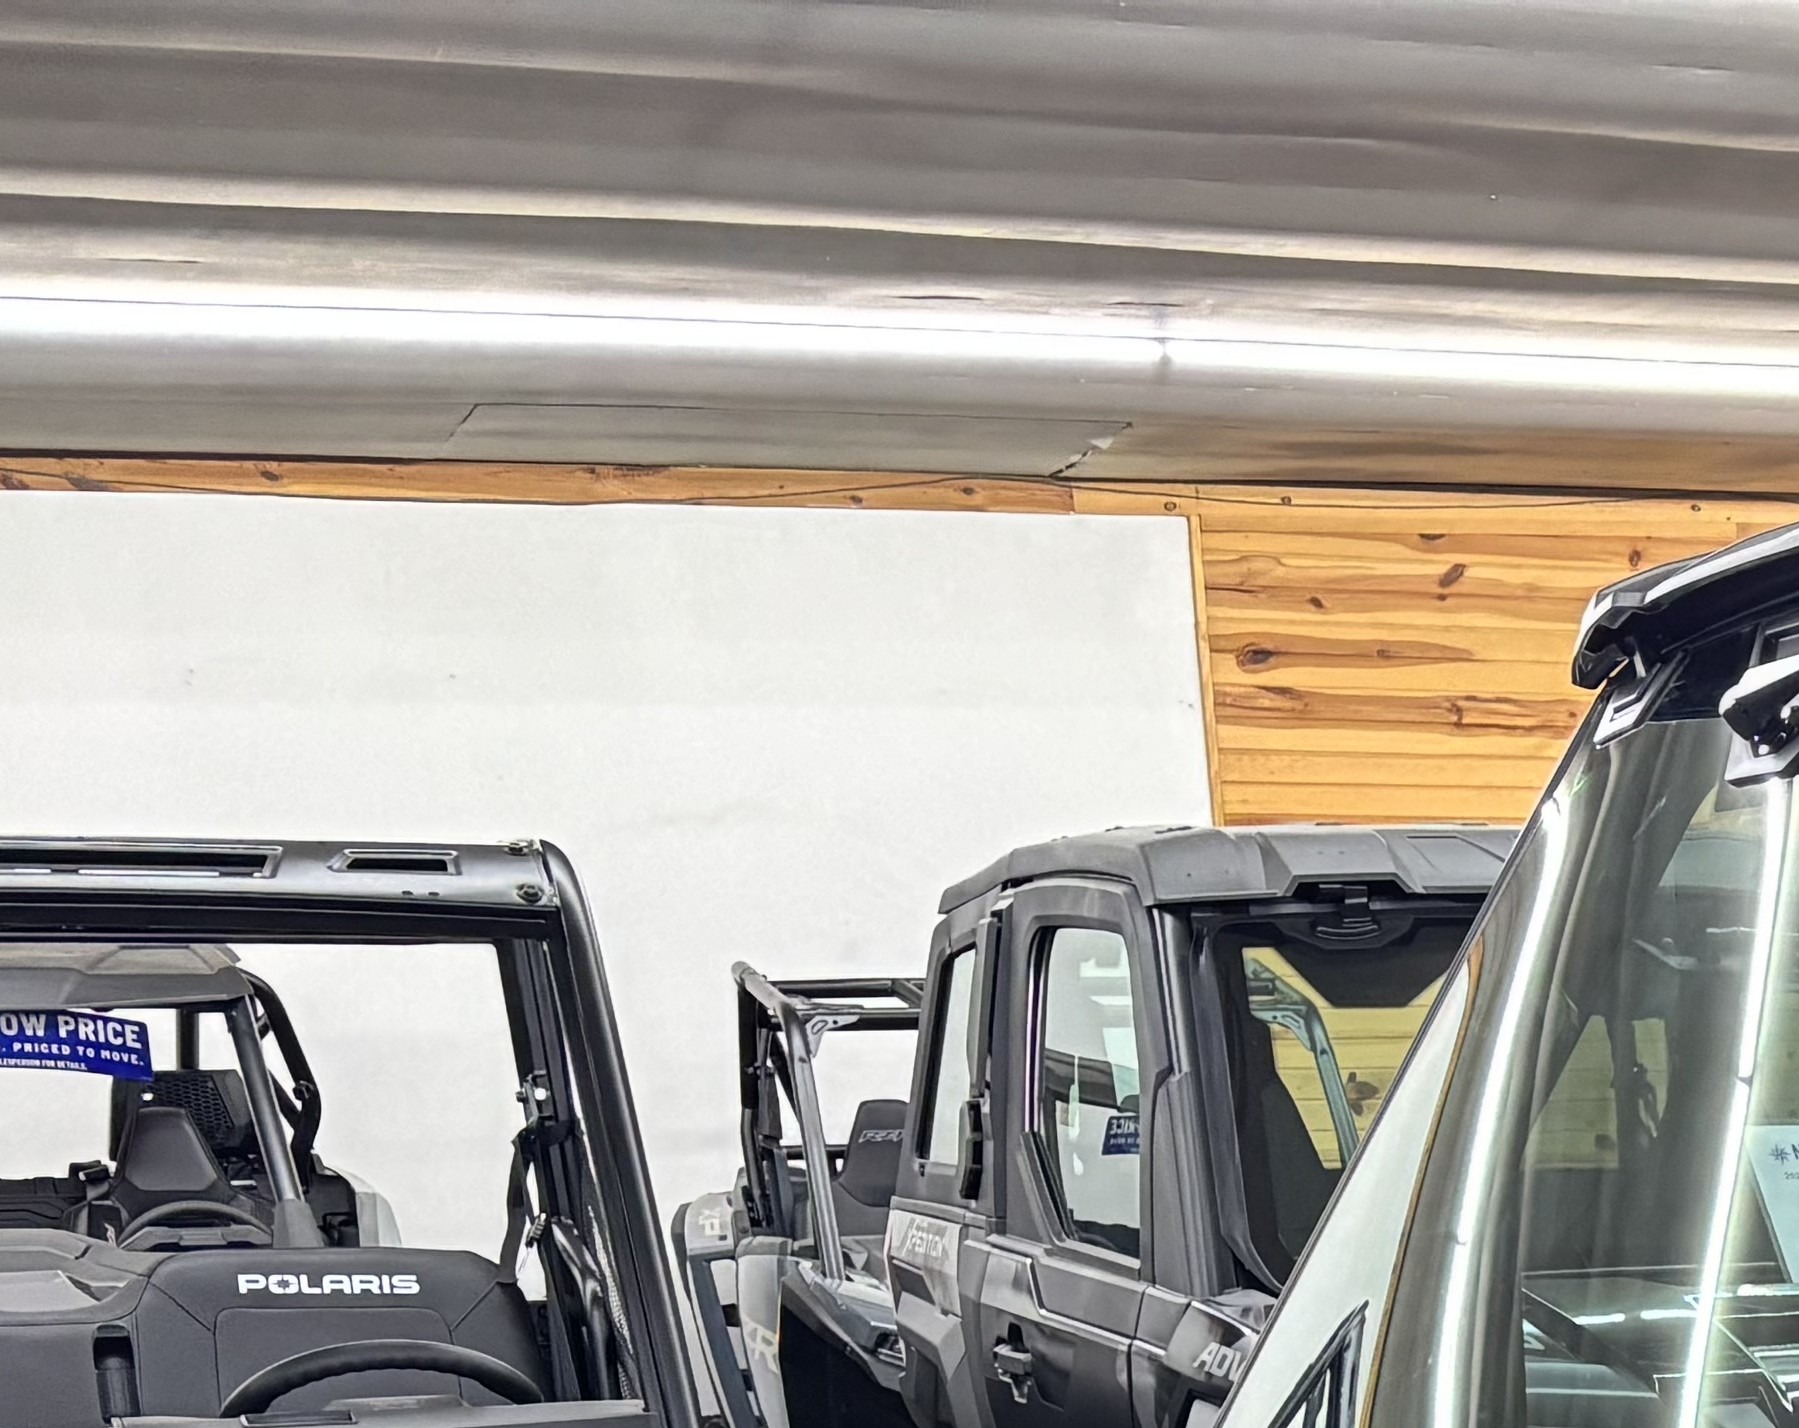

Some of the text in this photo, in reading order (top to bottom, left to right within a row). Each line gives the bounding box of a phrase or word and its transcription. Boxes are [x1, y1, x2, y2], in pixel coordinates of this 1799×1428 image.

[57, 1014, 142, 1050] PRICE
[12, 1041, 71, 1056] PRICED
[75, 1045, 95, 1059] TO
[237, 1274, 421, 1295] POLARIS
